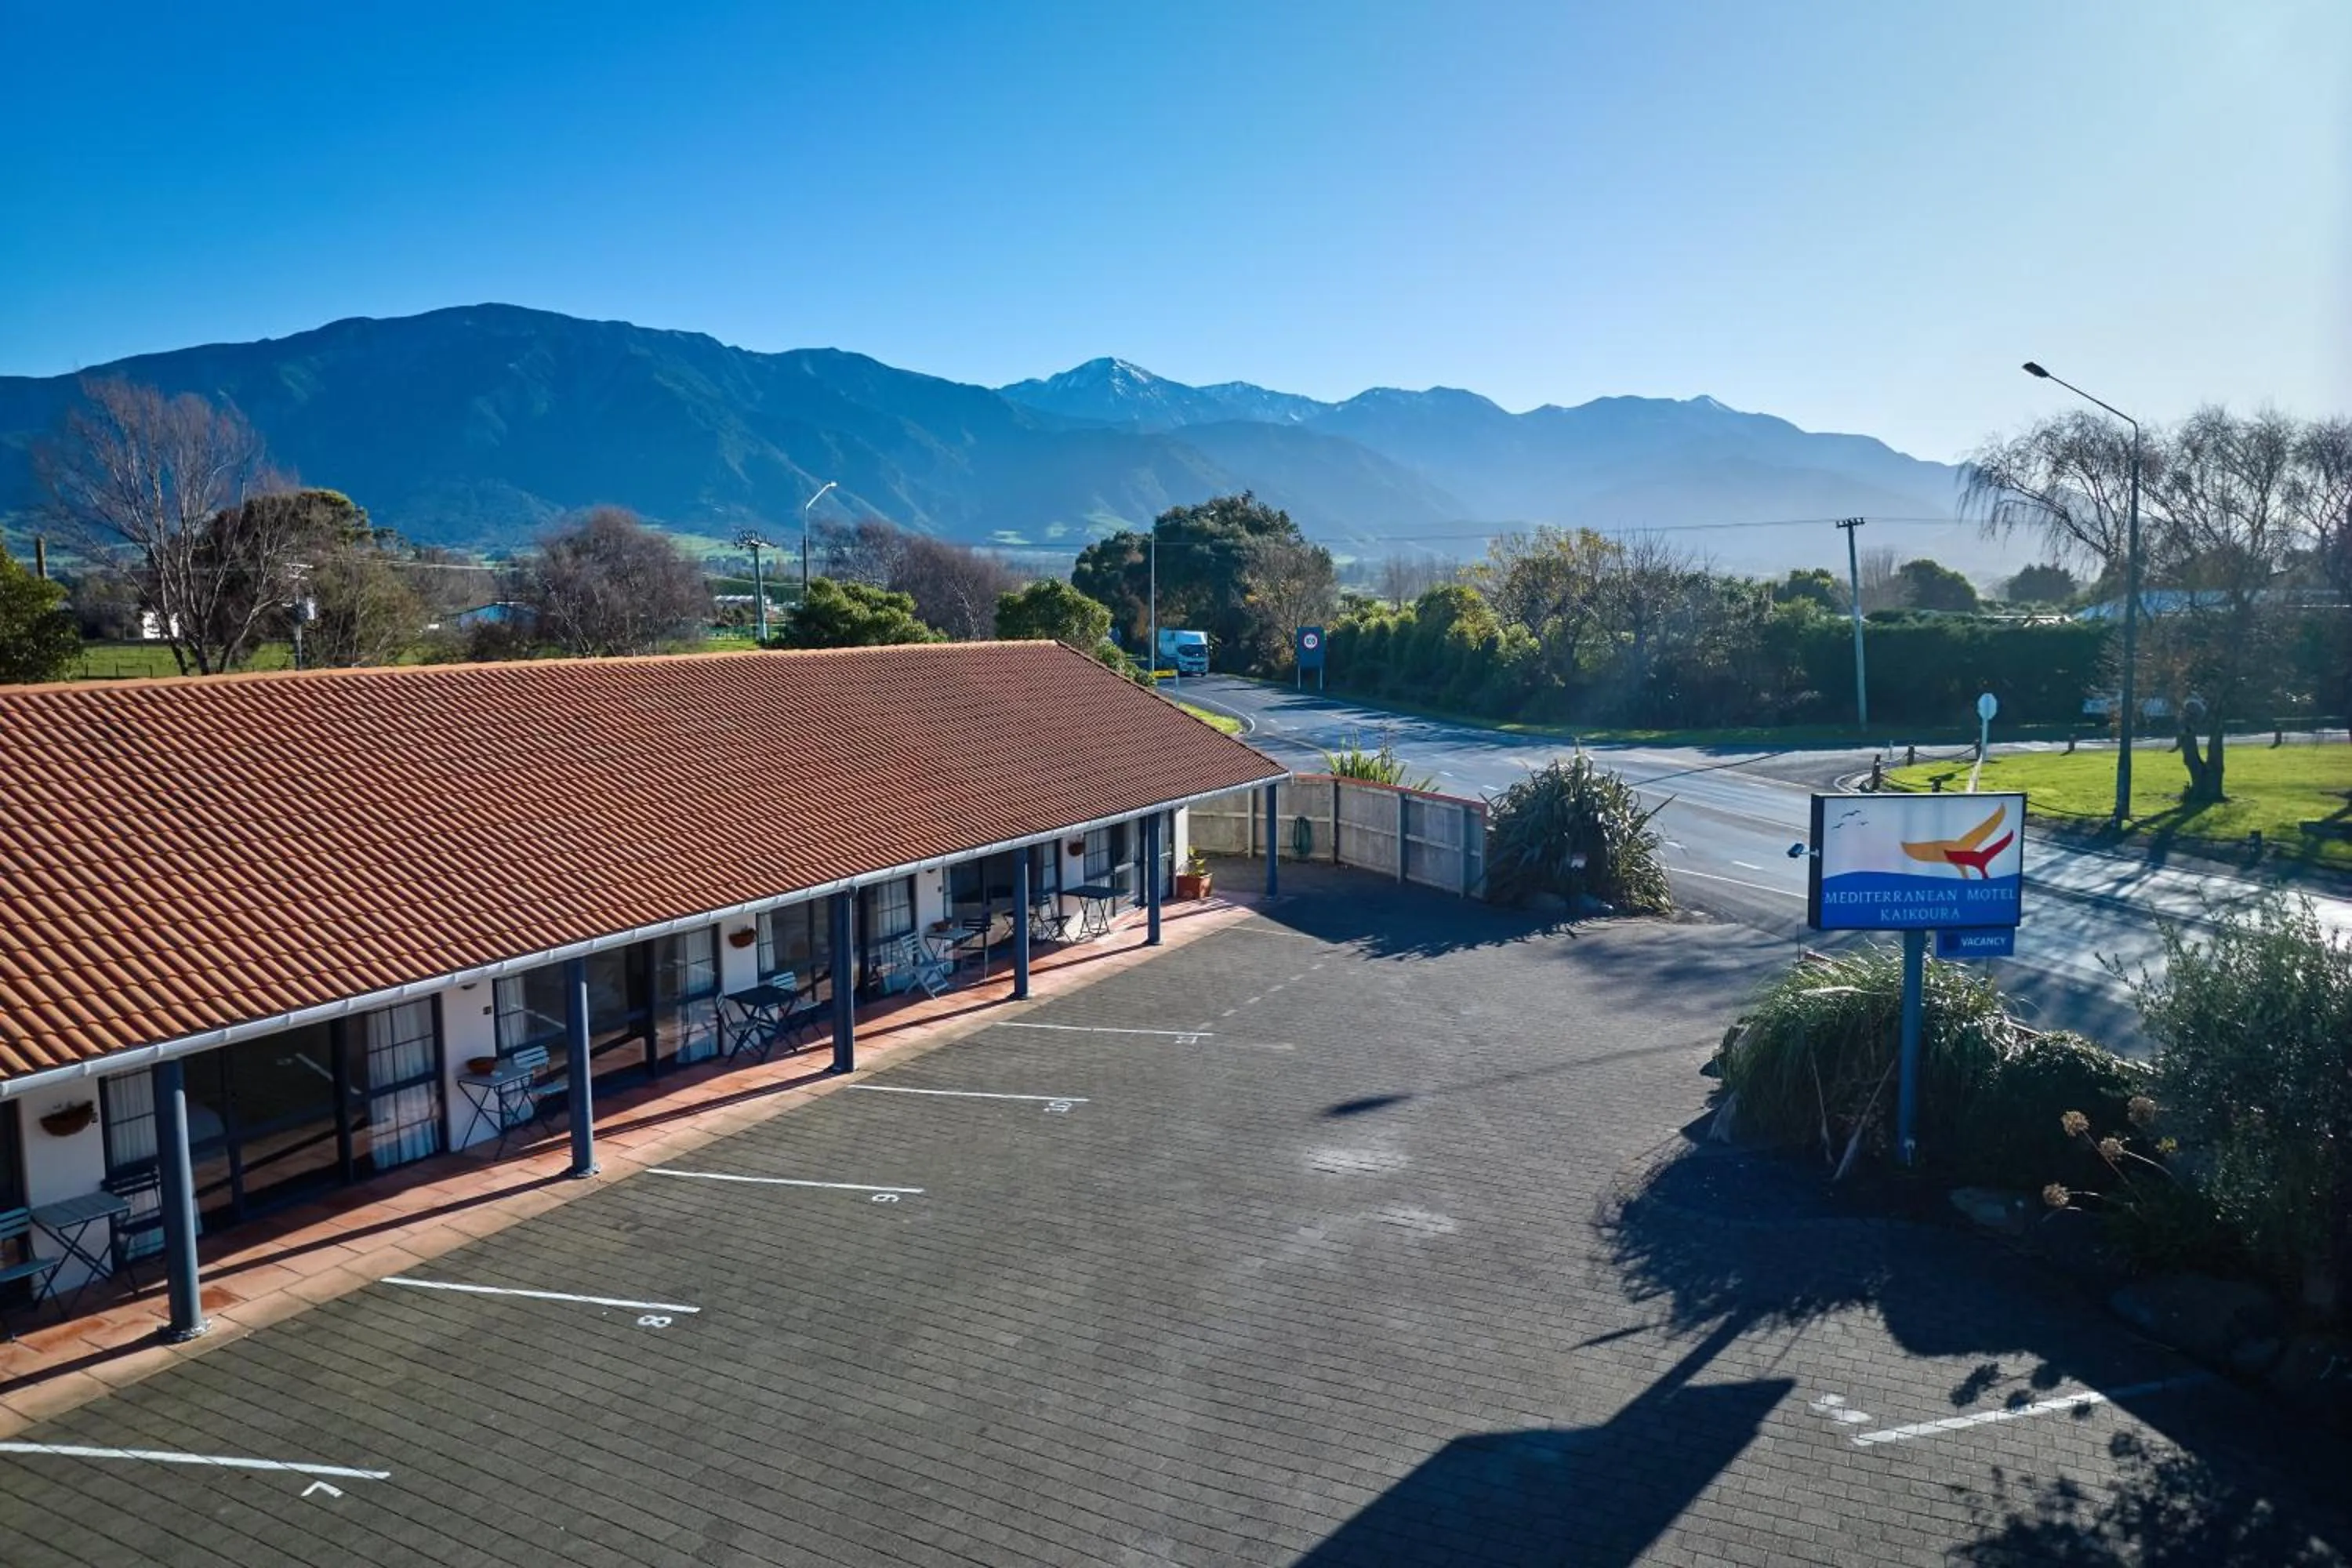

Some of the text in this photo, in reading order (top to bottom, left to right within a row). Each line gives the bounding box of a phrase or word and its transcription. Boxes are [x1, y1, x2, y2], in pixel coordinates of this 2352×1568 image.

[1825, 887, 2016, 903] MEDITERRANEAN MOTEL
[1881, 907, 1961, 921] KAIKOURA
[1961, 937, 2007, 946] VACANCY
[637, 1314, 672, 1328] 8
